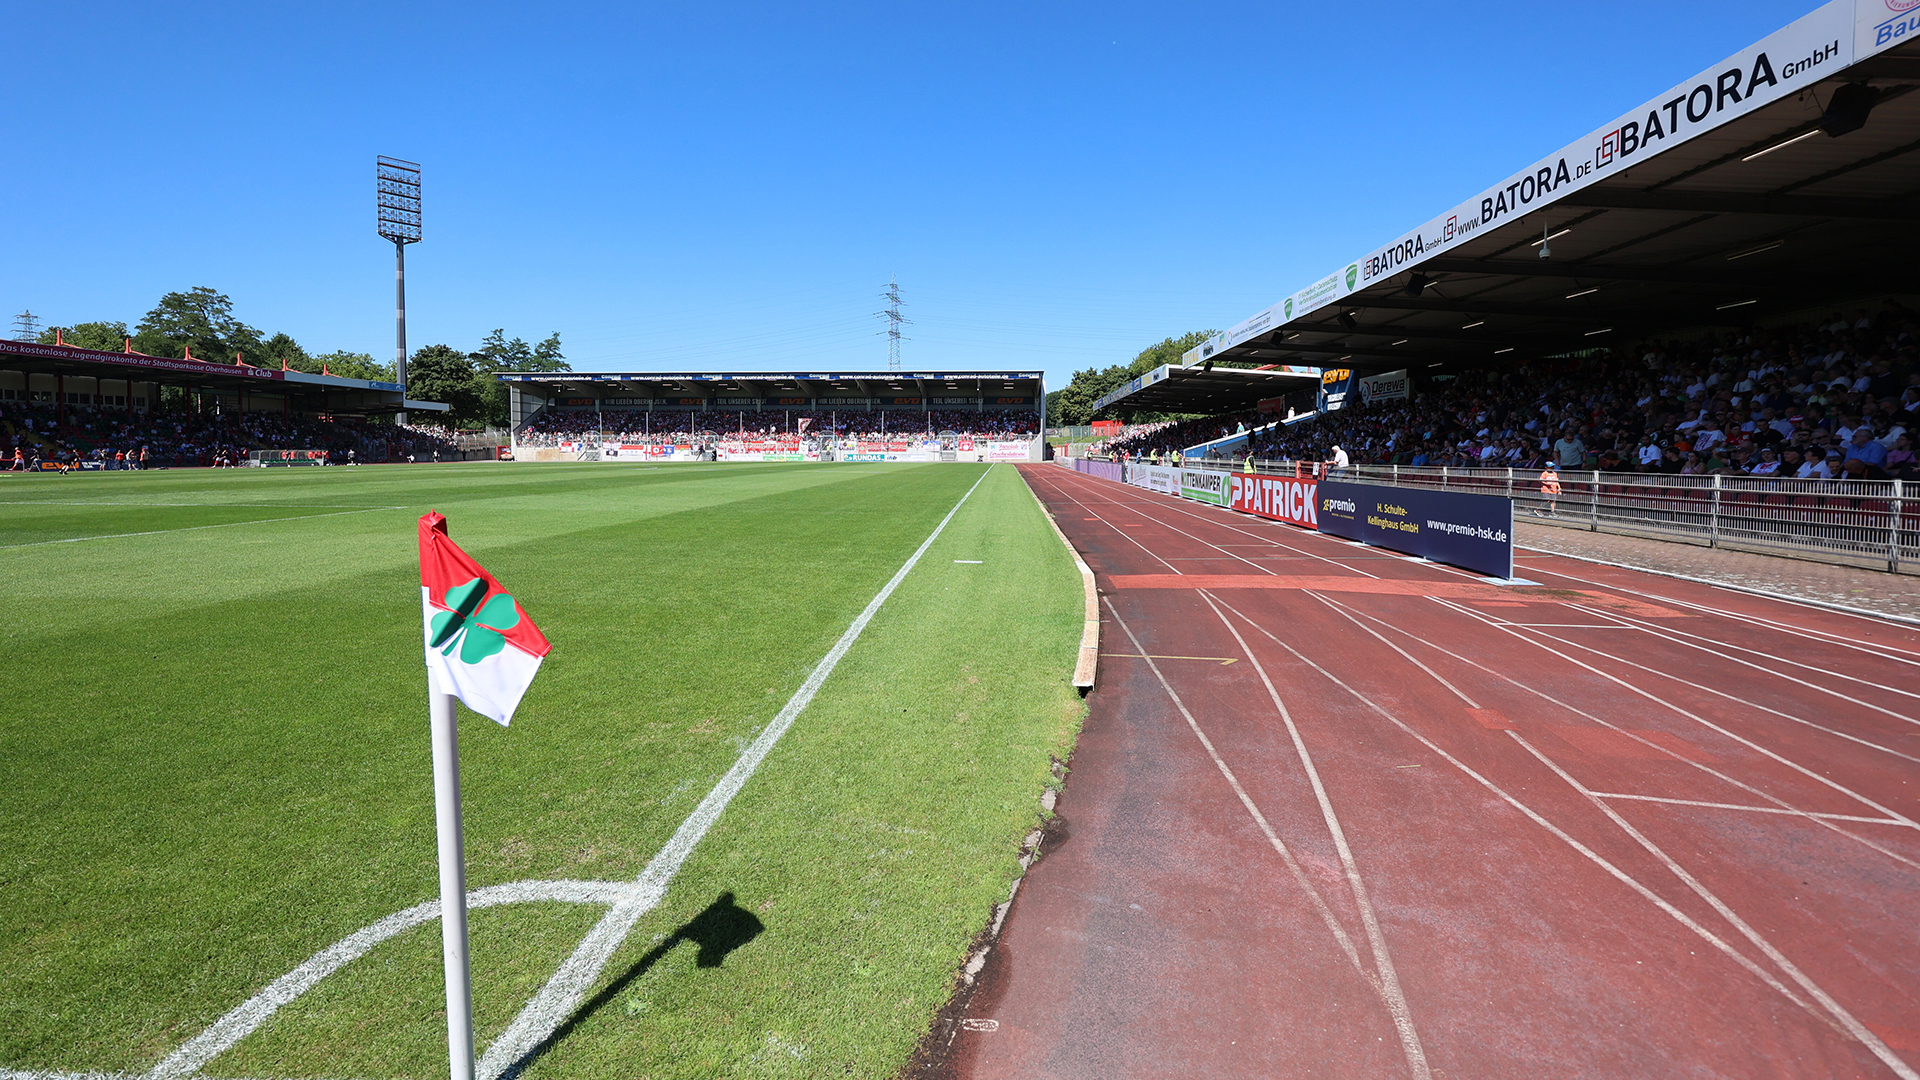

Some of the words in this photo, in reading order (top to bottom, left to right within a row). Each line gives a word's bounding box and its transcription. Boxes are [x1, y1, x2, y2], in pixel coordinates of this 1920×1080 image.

[1620, 52, 1778, 158] BATORA
[1782, 40, 1838, 80] GmbH
[1372, 233, 1424, 277] BATORA
[1425, 236, 1442, 252] GmbH
[0, 343, 18, 352] Das
[20, 346, 69, 358] kostenlose
[70, 351, 138, 365] Jugendgirokonto
[139, 358, 152, 366] der
[152, 360, 205, 372] Stadtsparkasse
[205, 365, 243, 375] Oberhausen
[255, 368, 273, 378] Club
[1372, 379, 1405, 394] Derewa
[1244, 477, 1318, 525] PATRICK
[1329, 498, 1356, 513] premio
[1377, 503, 1383, 513] H.
[1384, 504, 1408, 516] Schulte-
[1367, 515, 1399, 530] Kellinghaus
[1399, 521, 1419, 534] GmbH
[1427, 519, 1507, 543] www.premio-hsk.de
